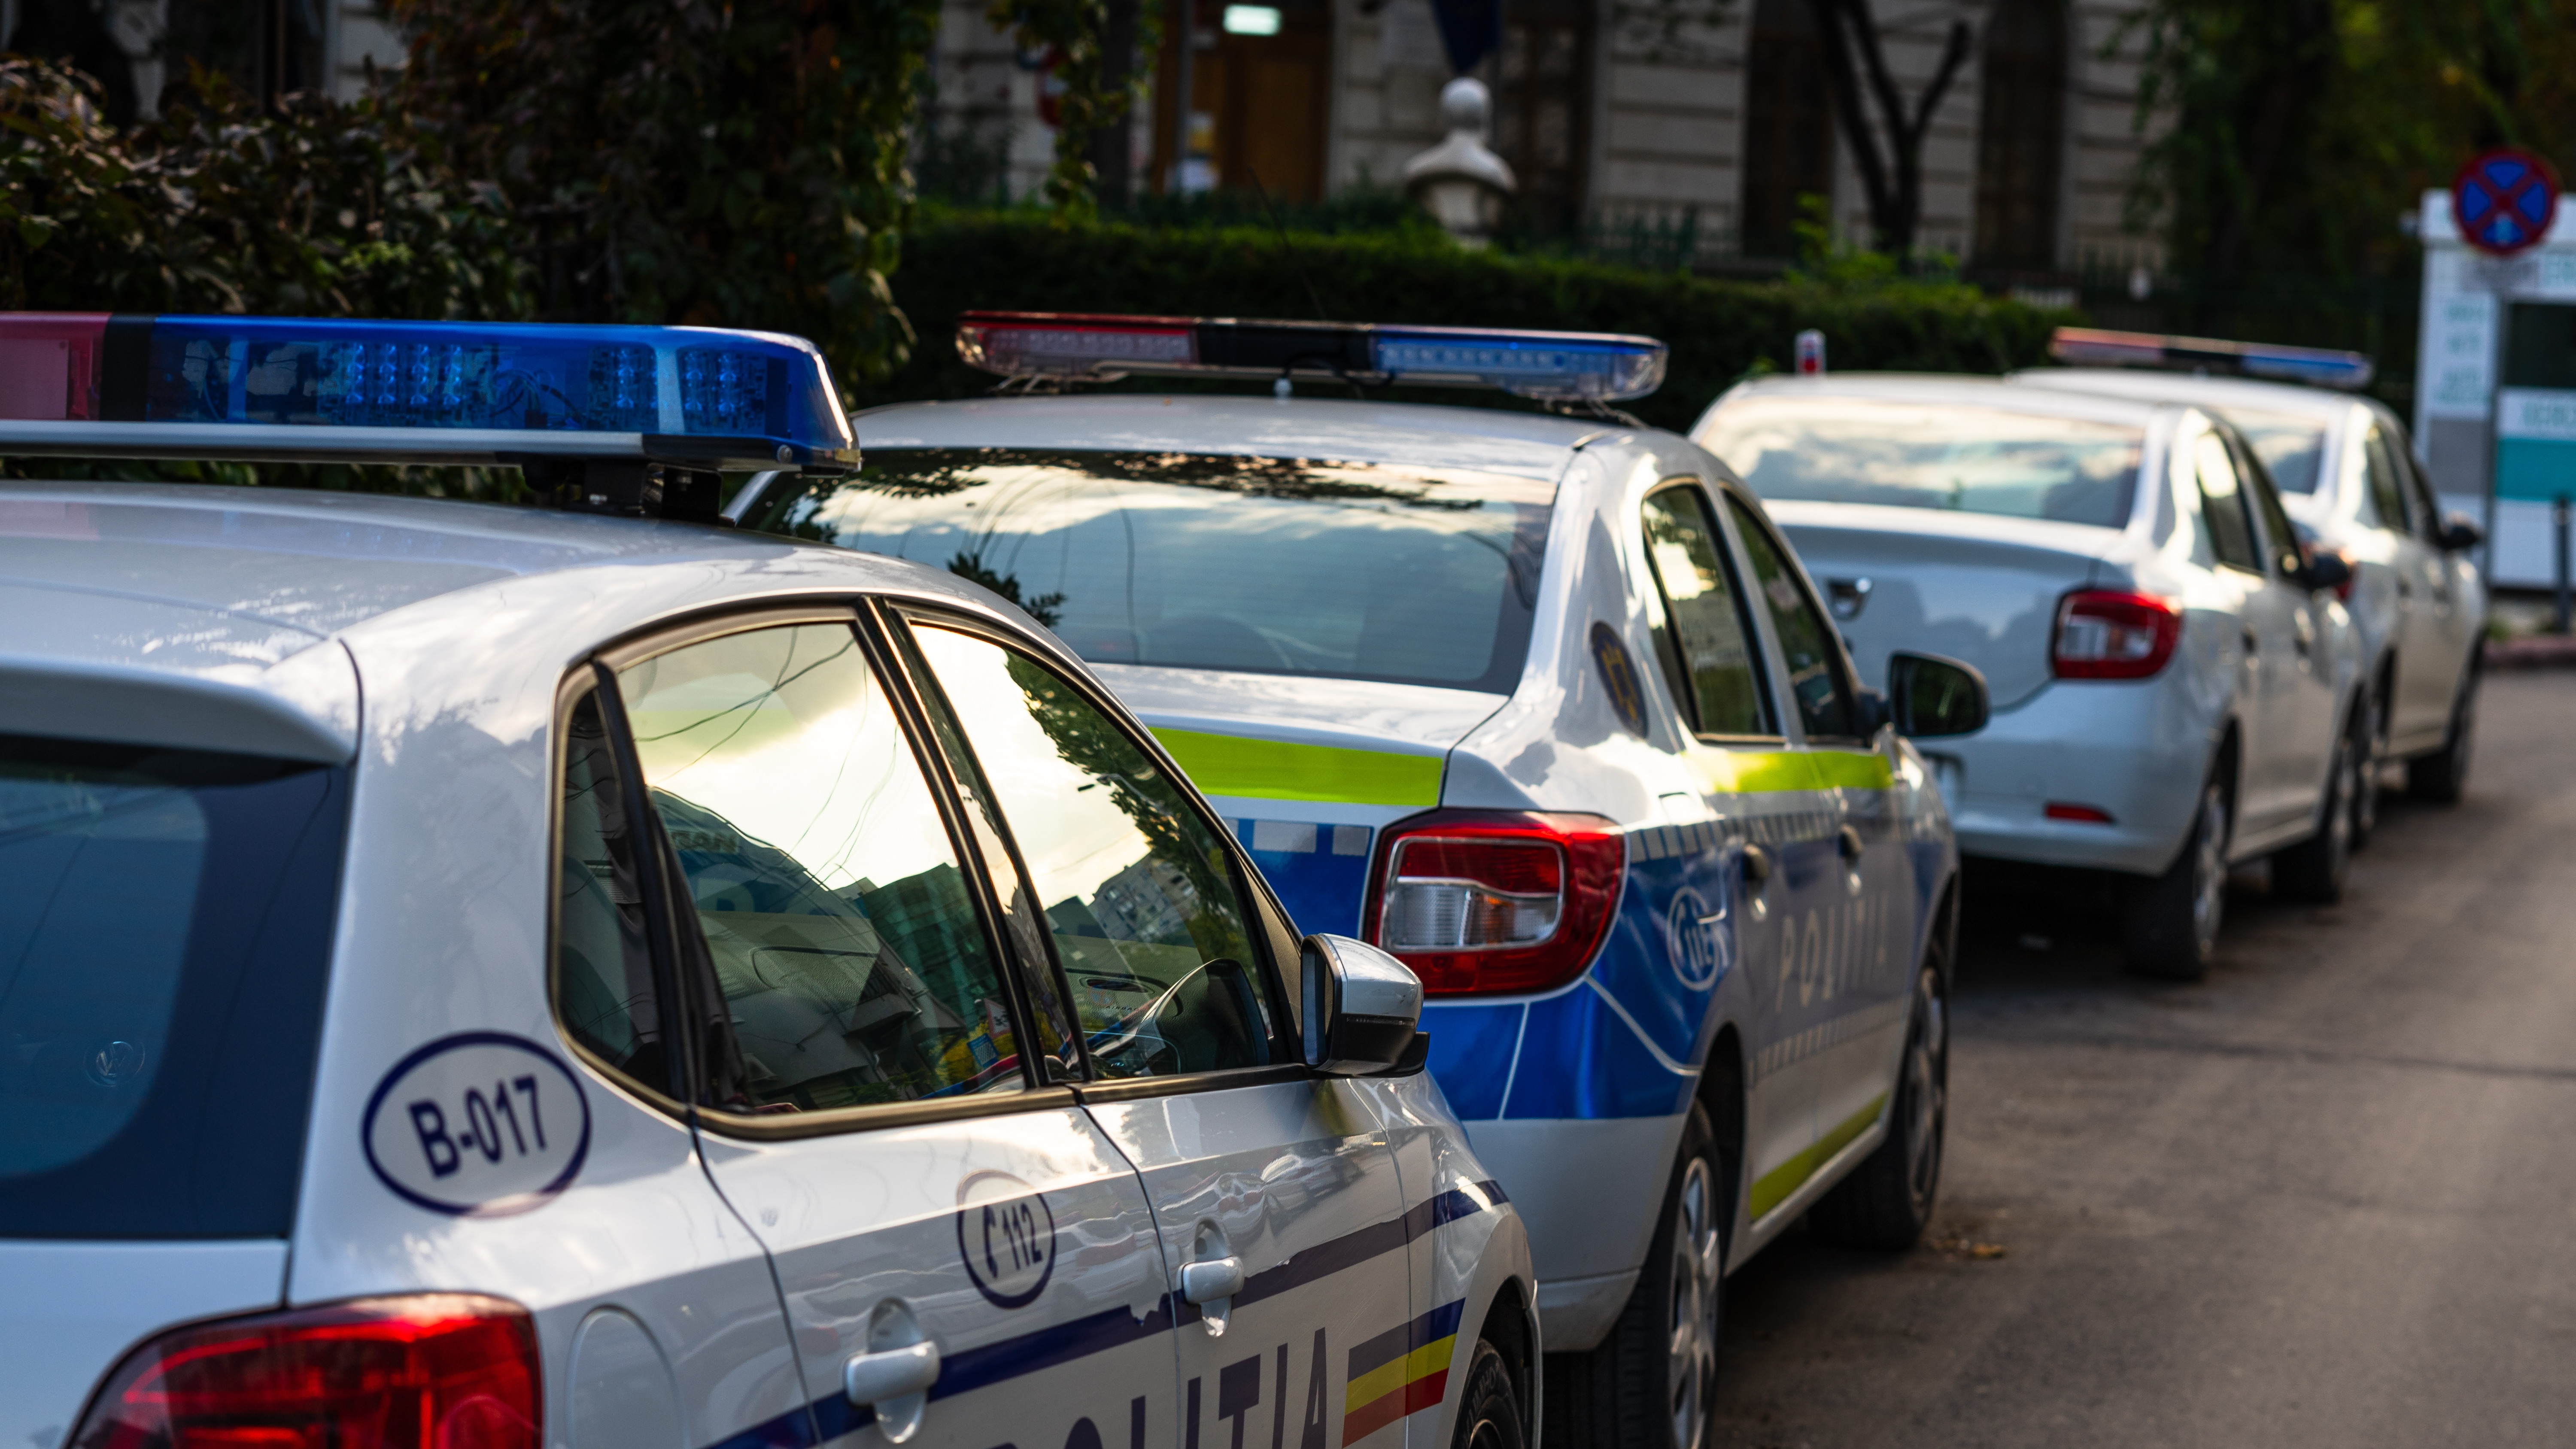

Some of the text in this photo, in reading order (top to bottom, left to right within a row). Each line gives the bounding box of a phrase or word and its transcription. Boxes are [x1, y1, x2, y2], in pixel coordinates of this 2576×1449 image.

[407, 1073, 547, 1178] B-017
[1002, 1202, 1042, 1270] 112
[983, 1327, 1327, 1449] ITIA
